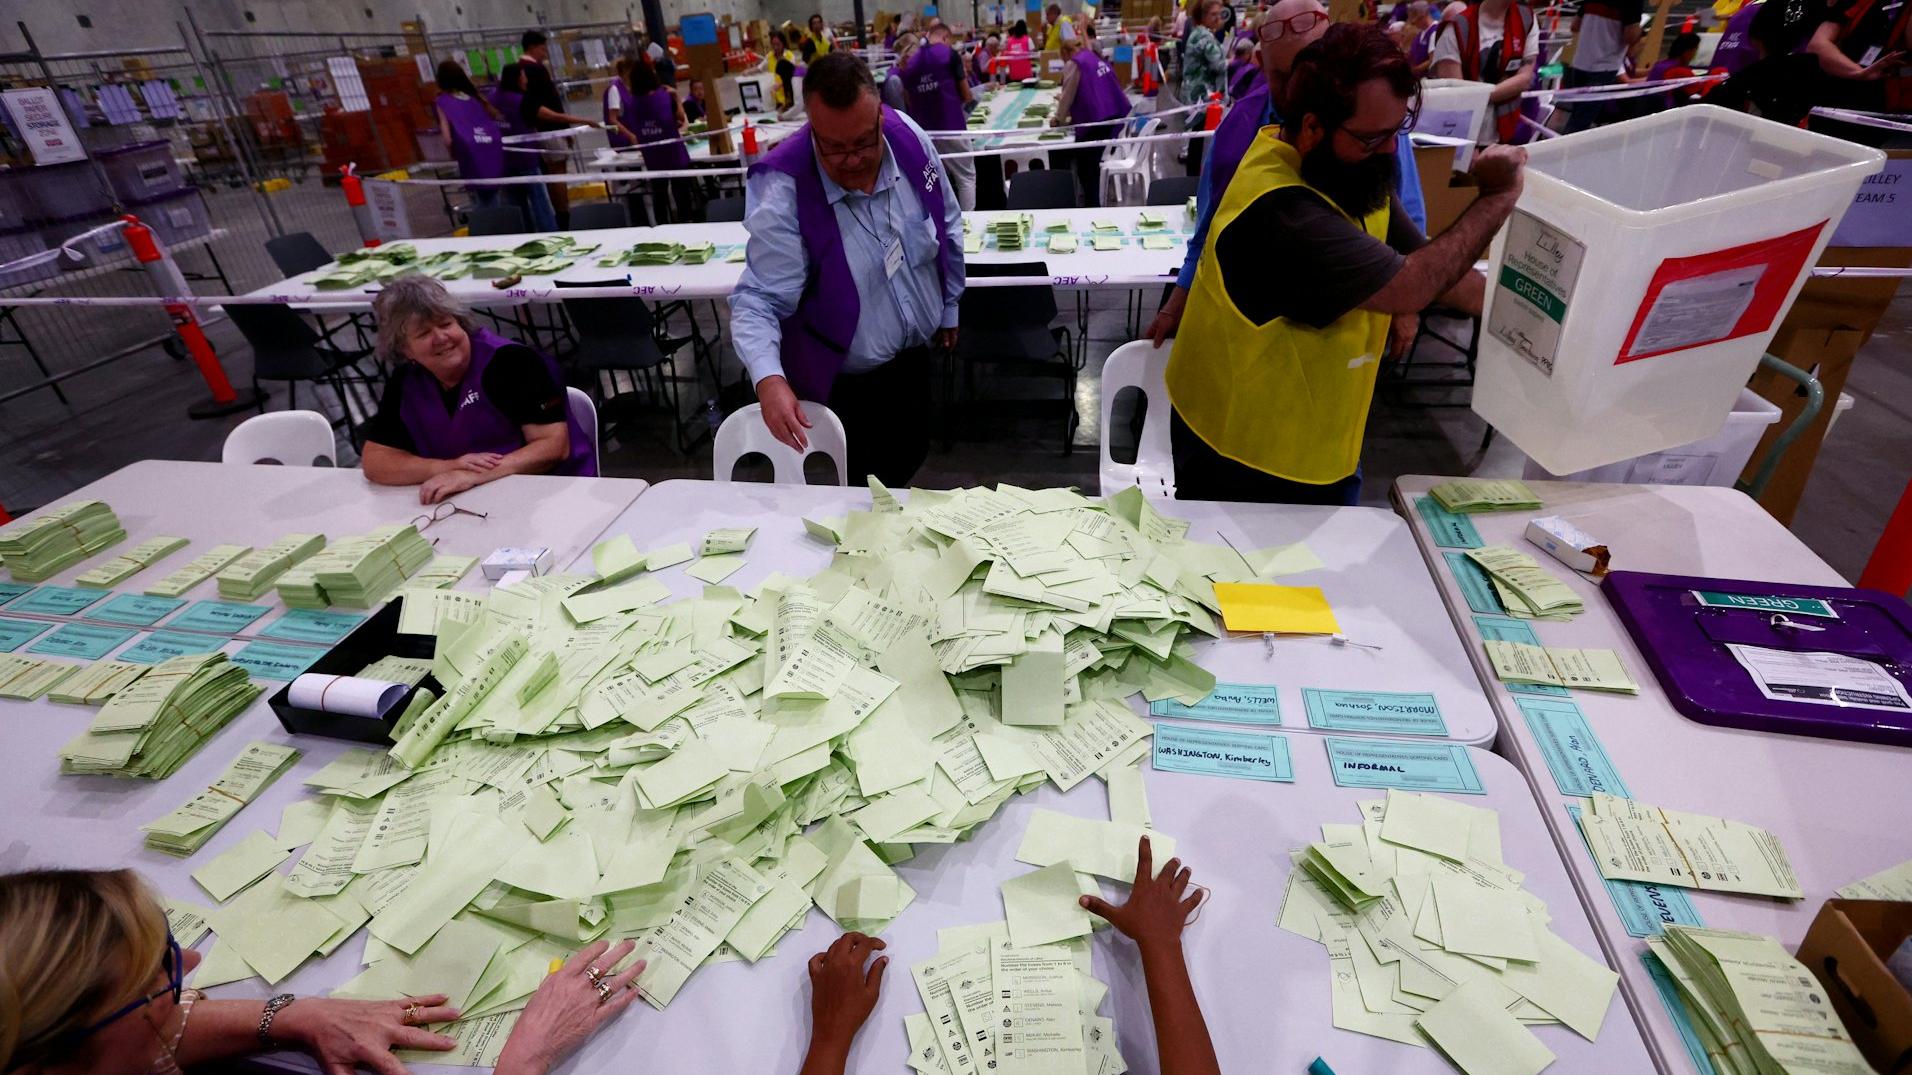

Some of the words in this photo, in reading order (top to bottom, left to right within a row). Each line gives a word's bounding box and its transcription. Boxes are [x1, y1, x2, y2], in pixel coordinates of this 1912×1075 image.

[921, 74, 934, 82] AEC
[917, 81, 939, 92] STAFF
[1855, 193, 1886, 203] EAM
[1887, 193, 1897, 203] 5
[1524, 250, 1549, 271] House
[1053, 276, 1080, 286] AEC
[1508, 254, 1566, 298] Representatives
[633, 286, 655, 295] AEC
[1515, 278, 1552, 310] GREEN
[1727, 595, 1800, 610] GREEN
[1244, 695, 1275, 705] WELLS,
[1335, 702, 1373, 711] Joshua
[1375, 703, 1435, 713] MORRISON,
[1158, 747, 1222, 761] WASHINGTON,
[1225, 753, 1271, 767] Kimberley
[1343, 762, 1406, 773] INFORMAL
